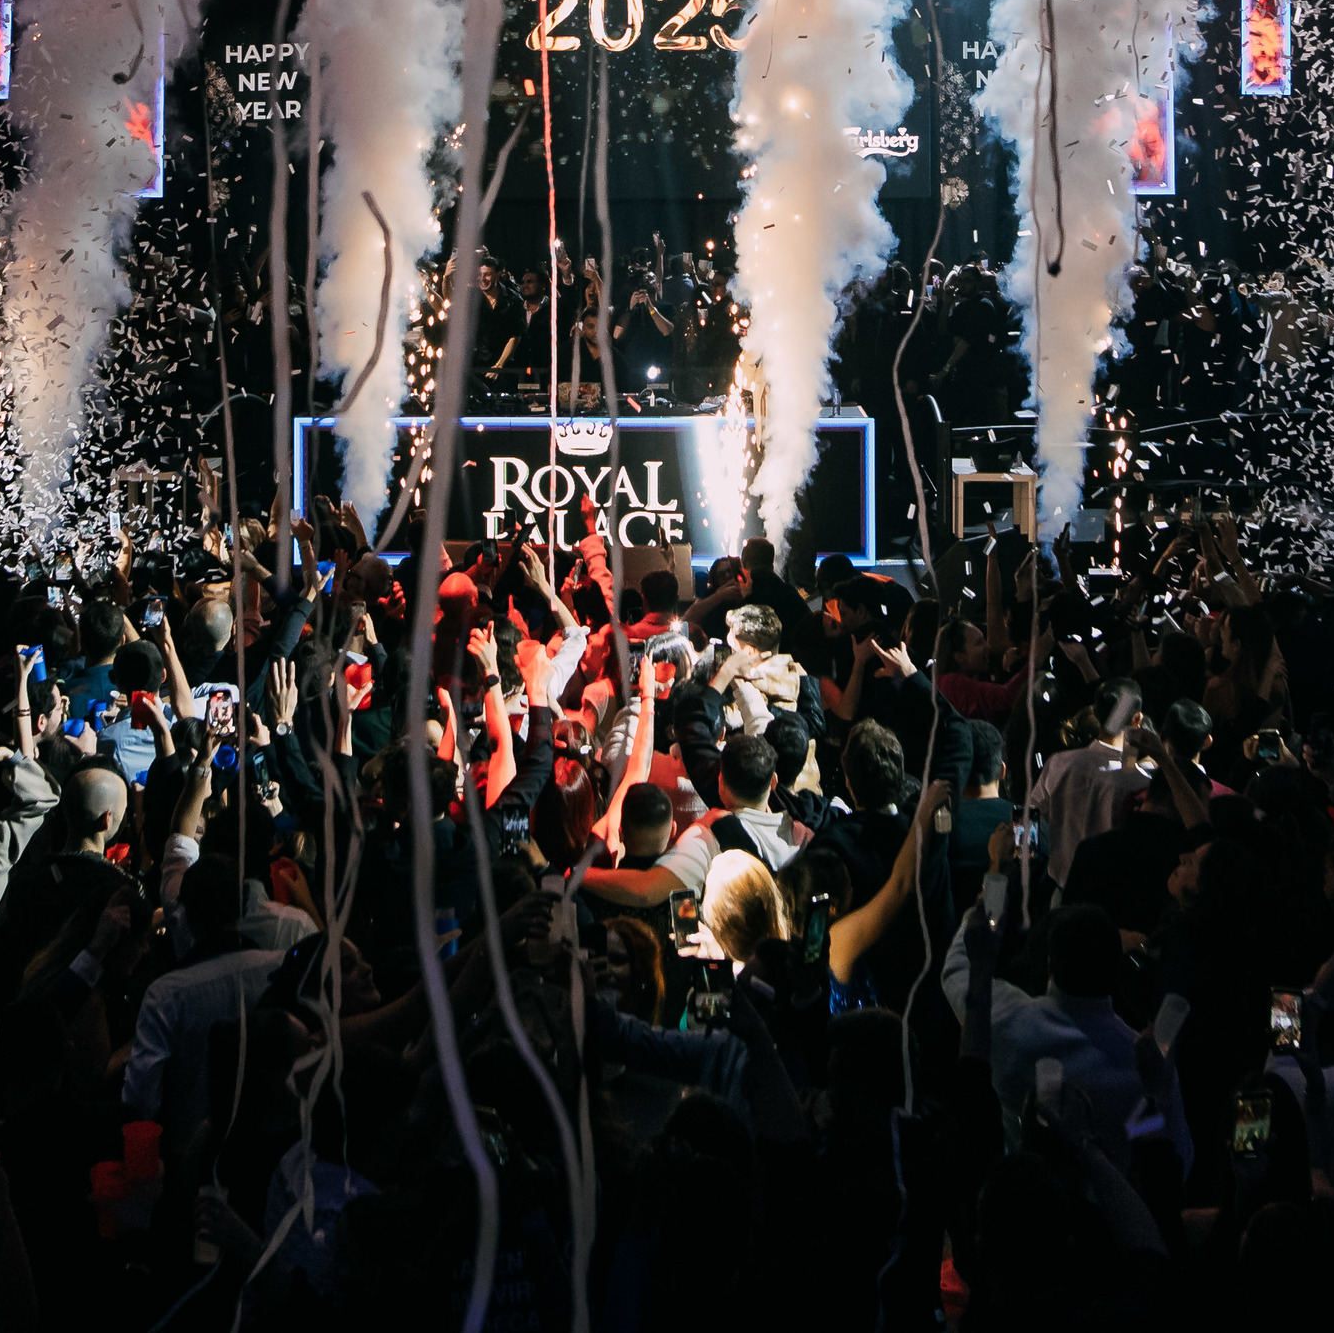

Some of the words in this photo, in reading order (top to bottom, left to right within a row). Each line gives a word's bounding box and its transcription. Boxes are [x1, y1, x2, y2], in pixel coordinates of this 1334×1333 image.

[225, 42, 310, 63] HAPPY
[238, 71, 298, 91] NEW
[236, 100, 301, 120] YEAR
[489, 456, 679, 514] ROYAL
